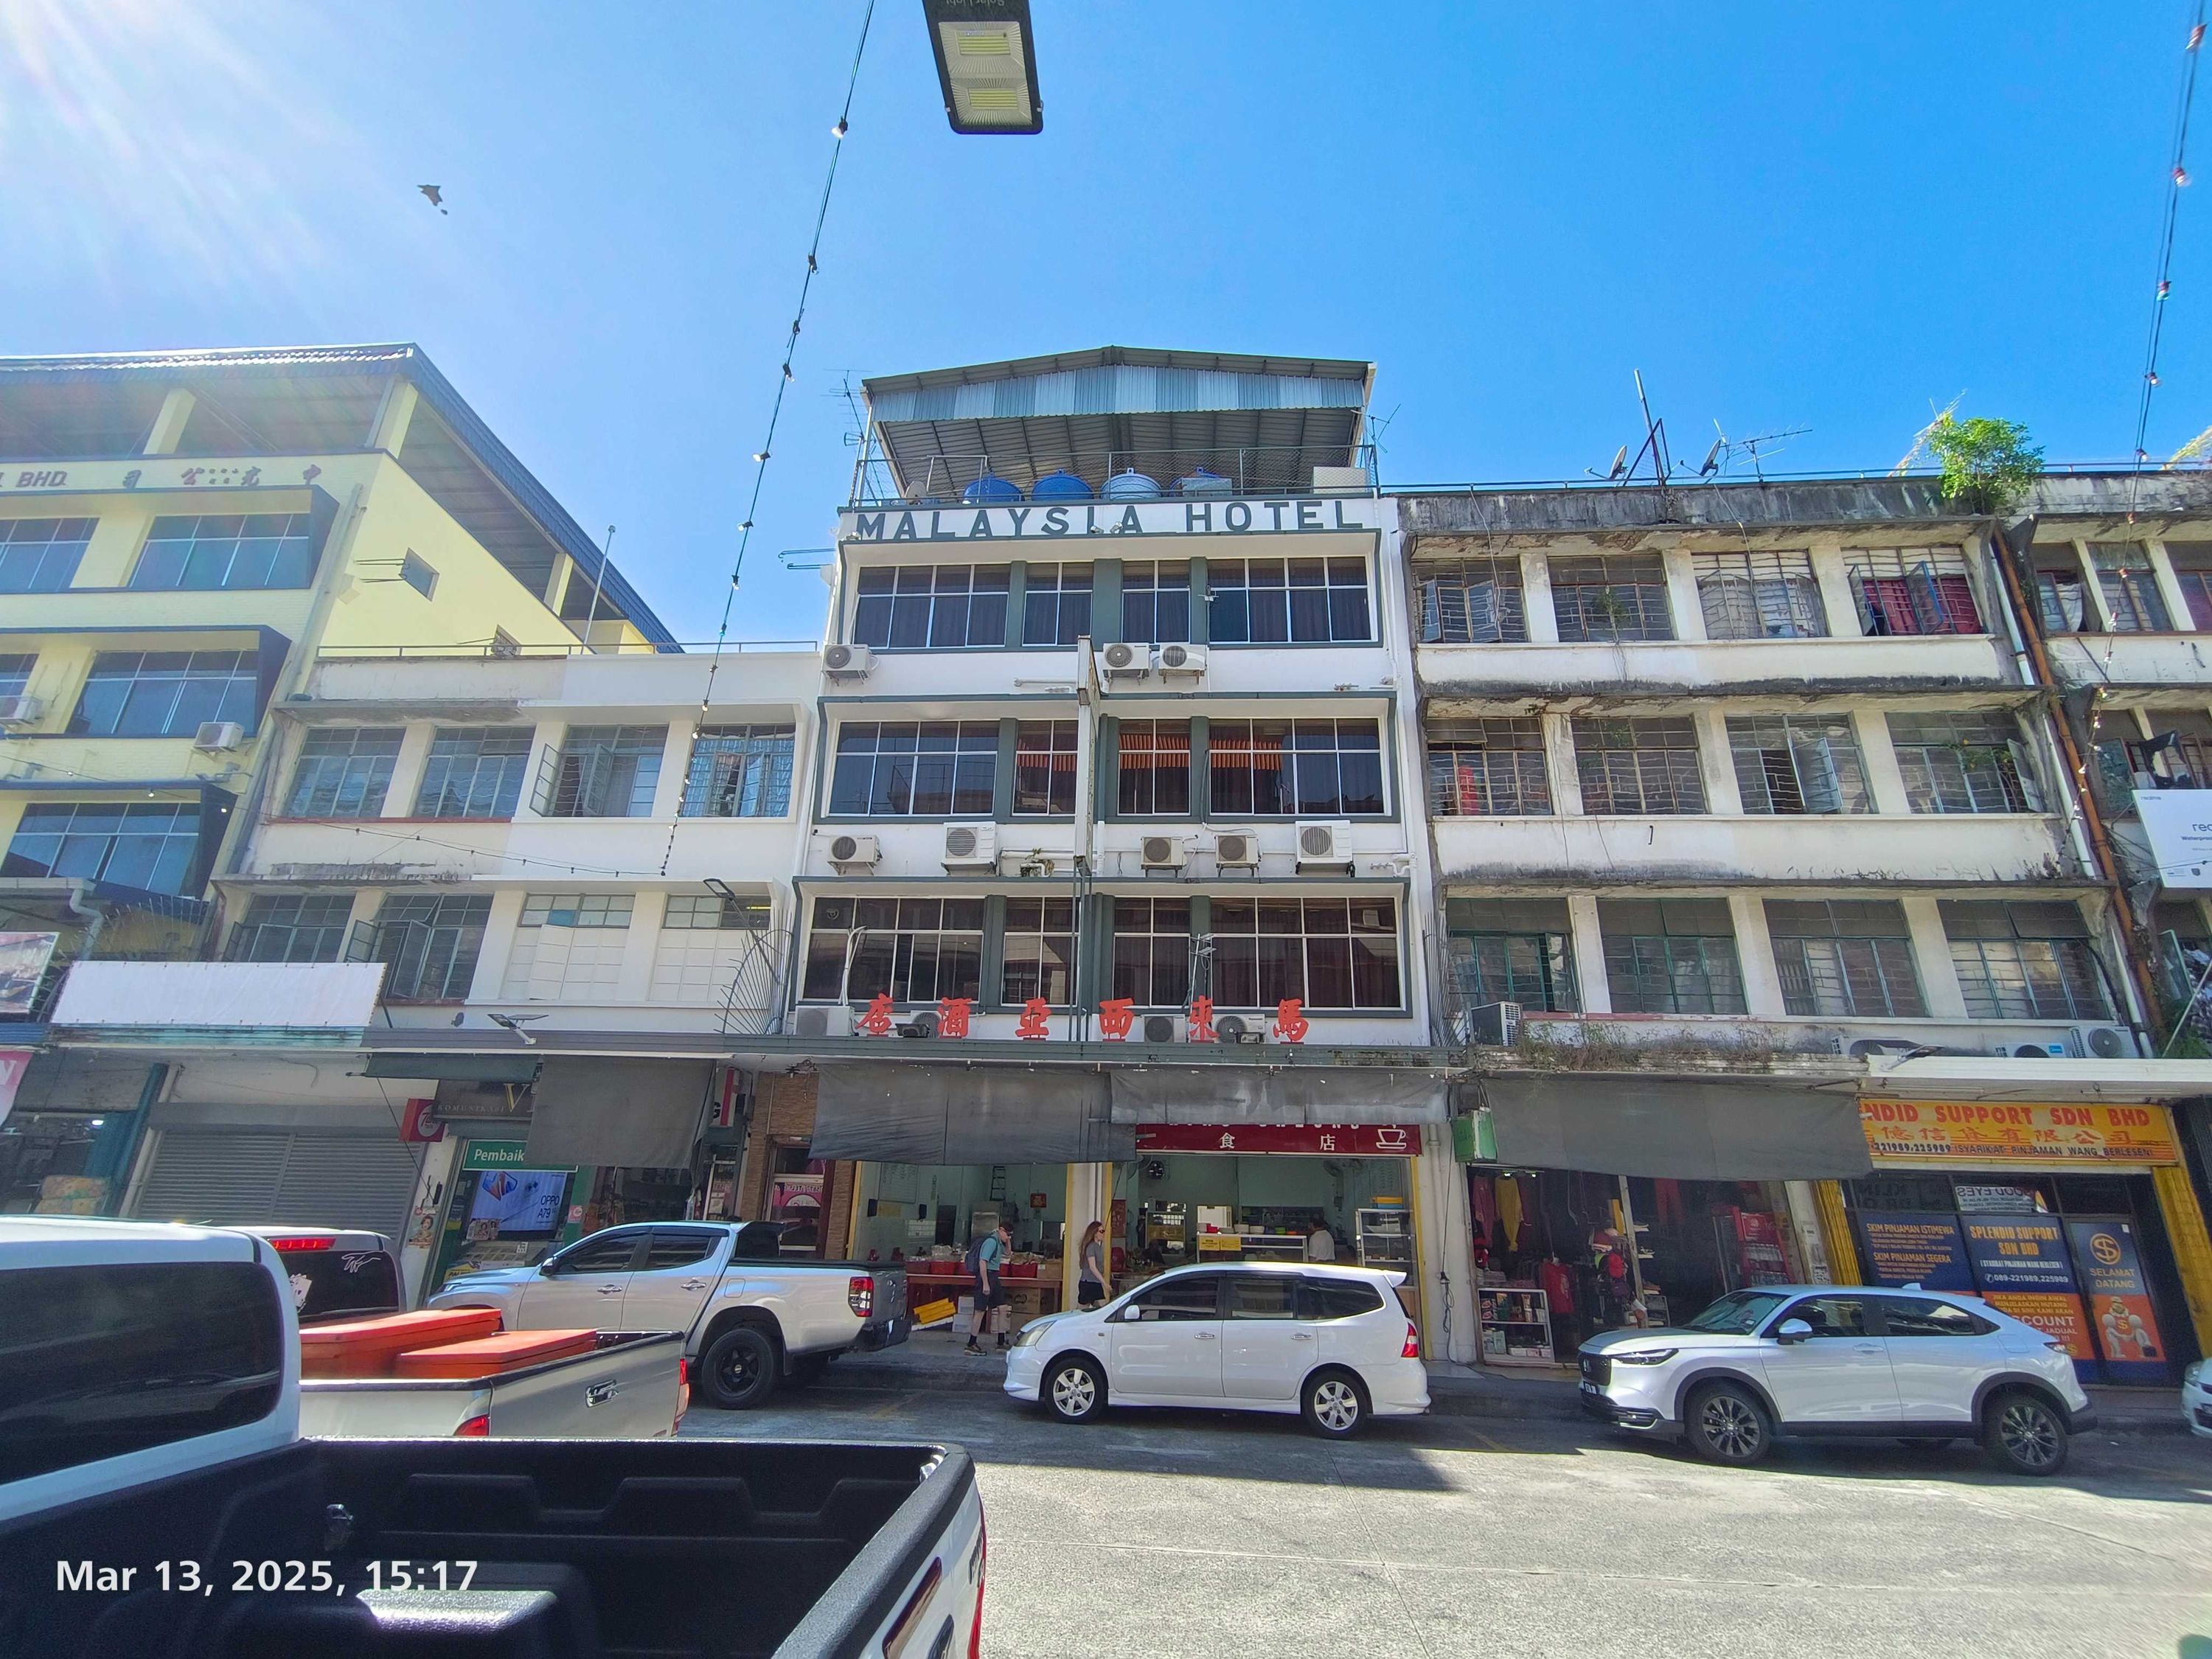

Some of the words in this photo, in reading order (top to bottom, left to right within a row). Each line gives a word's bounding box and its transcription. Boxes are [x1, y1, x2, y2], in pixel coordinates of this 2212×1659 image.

[856, 505, 1143, 541] MALAYSIA
[1186, 500, 1363, 534] HOTEL
[1859, 1103, 1919, 1122] NDID
[1935, 1105, 2033, 1125] SUPPORT
[2050, 1107, 2093, 1126] SDN
[2107, 1108, 2150, 1127] BHD
[2011, 1146, 2062, 1155] PINJAMAN
[2067, 1147, 2098, 1155] WANG
[540, 1195, 560, 1206] OPPO
[537, 1208, 551, 1218] A79
[1866, 1223, 1884, 1232] SKIM
[1885, 1224, 1920, 1234] PINJAMAN
[1920, 1225, 1955, 1235] ISTIMEWA
[1969, 1225, 2016, 1239] SPLENDID
[2016, 1226, 2059, 1239] SUPPORT
[1998, 1242, 2018, 1255] SDN
[1873, 1252, 1891, 1261] SKIM
[1891, 1253, 1925, 1262] PINJAMAN
[1926, 1253, 1952, 1263] SEGERA
[2090, 1267, 2135, 1277] SELAMAT
[2095, 1279, 2135, 1289] DATANG
[2012, 1315, 2075, 1326] COUNT
